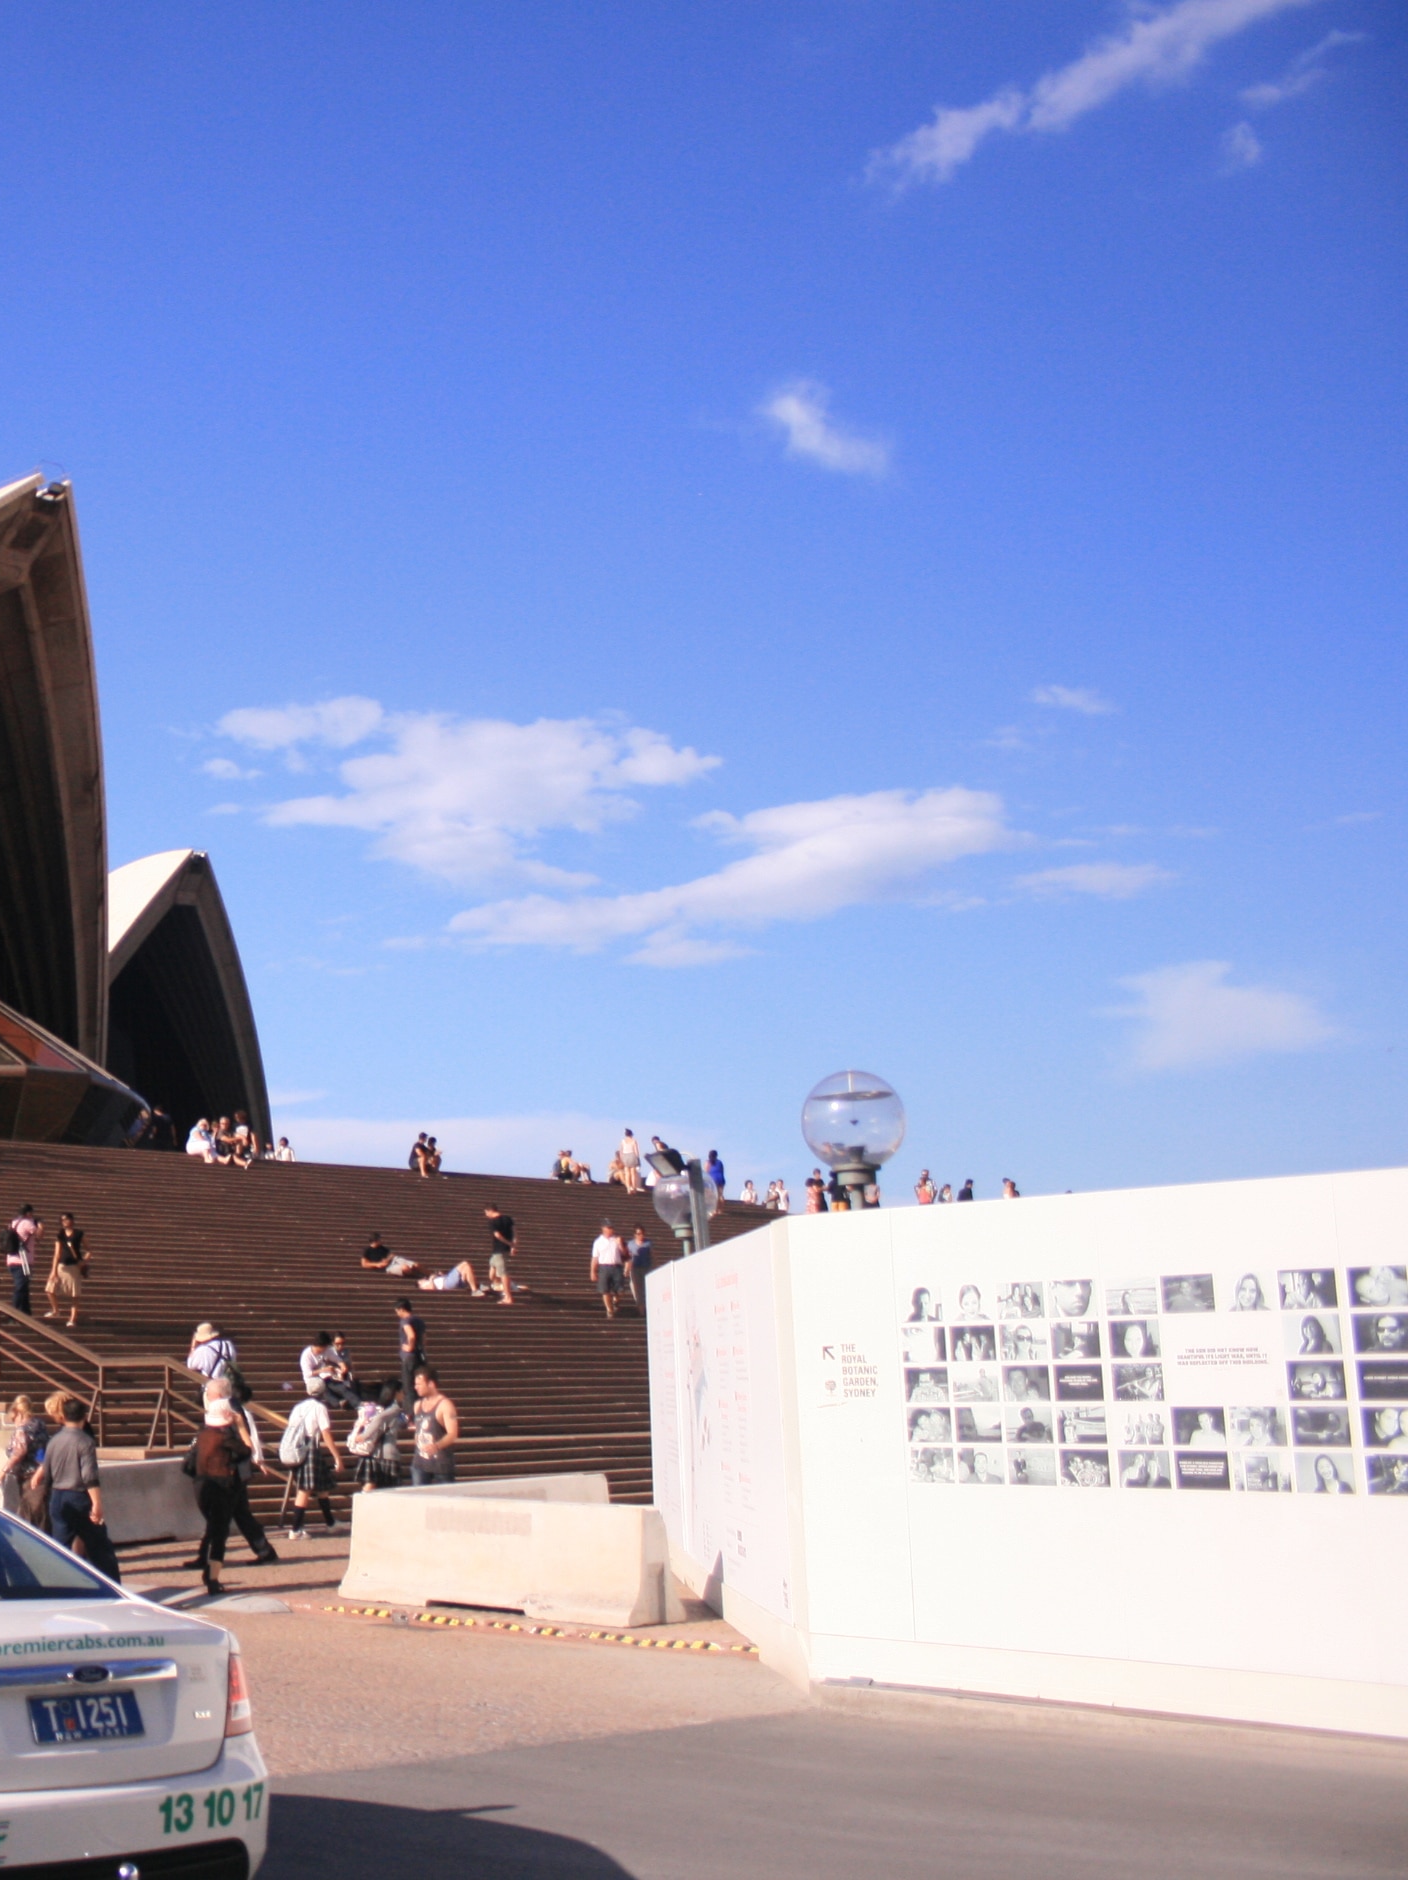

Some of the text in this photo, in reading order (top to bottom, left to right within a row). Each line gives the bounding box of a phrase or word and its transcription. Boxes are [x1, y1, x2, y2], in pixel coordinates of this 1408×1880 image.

[840, 1344, 856, 1353] THE
[842, 1355, 867, 1364] ROYAL
[842, 1365, 878, 1375] BOTANIC
[843, 1377, 879, 1387] GARDEN,
[844, 1388, 876, 1398] SYDNEY
[159, 1781, 265, 1834] 13 10 17
